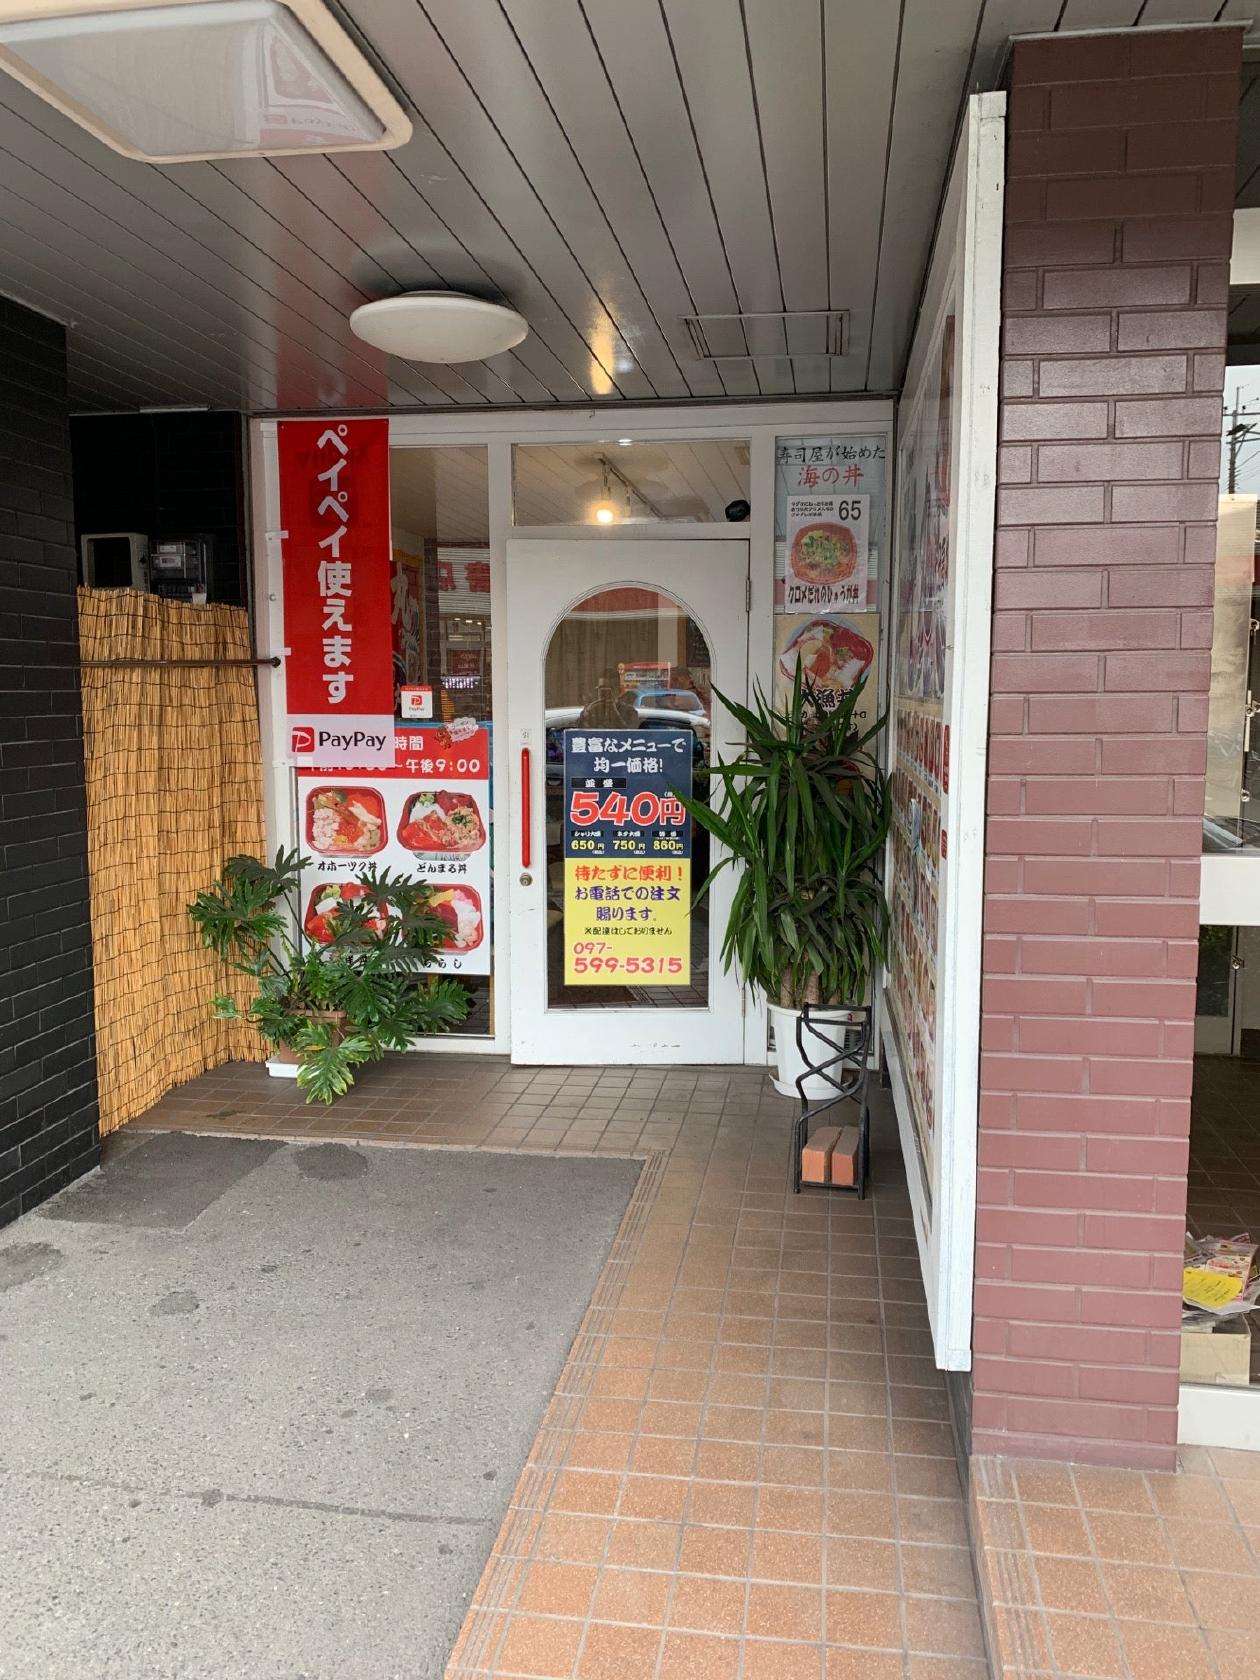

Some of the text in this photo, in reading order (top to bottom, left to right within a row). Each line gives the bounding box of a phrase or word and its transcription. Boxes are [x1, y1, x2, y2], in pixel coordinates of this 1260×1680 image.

[776, 446, 886, 464] 寿司屋が始めた
[838, 500, 862, 521] 65
[316, 424, 354, 704] ペイペイ使えます
[318, 730, 386, 752] PayPay
[570, 737, 687, 753] 豊富なメニューで
[570, 791, 686, 826] 540円
[317, 861, 378, 872] オホーツク丼
[416, 863, 469, 874] どんまる丼
[575, 885, 681, 901] お電話での注文
[595, 906, 657, 922] 賜ります。
[573, 942, 613, 955] 097-
[573, 957, 683, 974] 599-5315
